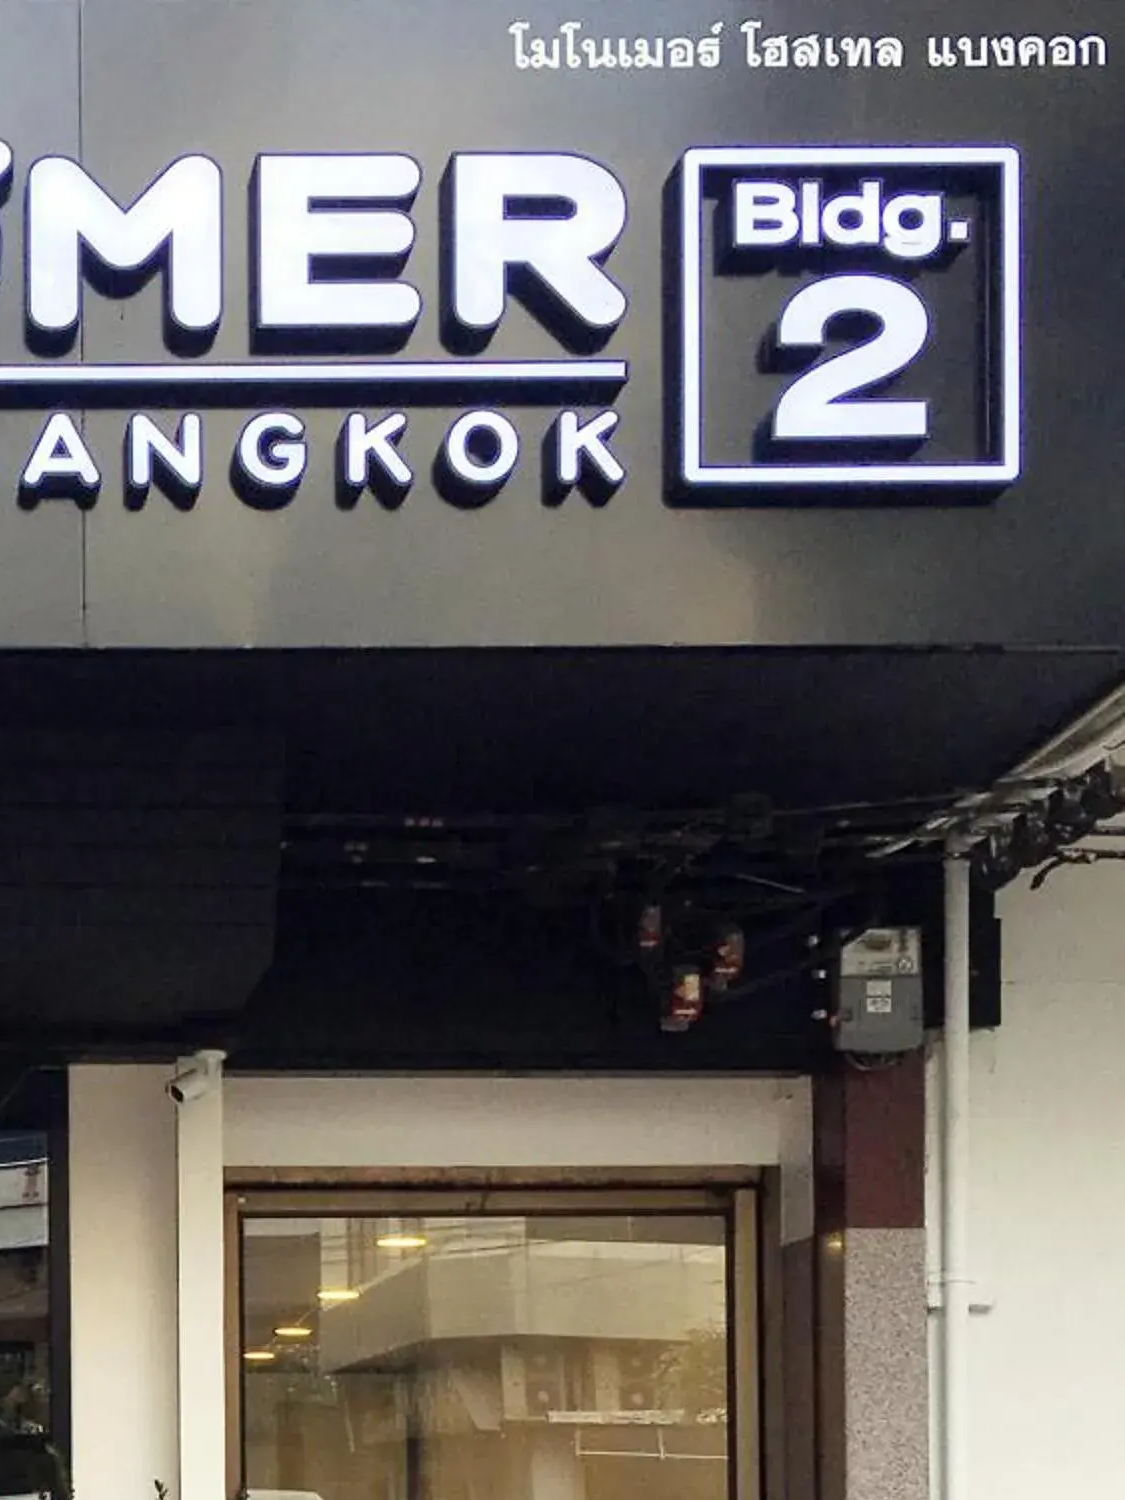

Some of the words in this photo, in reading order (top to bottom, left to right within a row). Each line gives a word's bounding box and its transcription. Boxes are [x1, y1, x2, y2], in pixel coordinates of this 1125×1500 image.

[508, 21, 724, 70] โมโนเมอร์
[740, 21, 903, 67] โฮสเทล
[928, 36, 1106, 67] แบงคอก
[735, 181, 968, 258] Bldg.
[774, 274, 928, 438] 2
